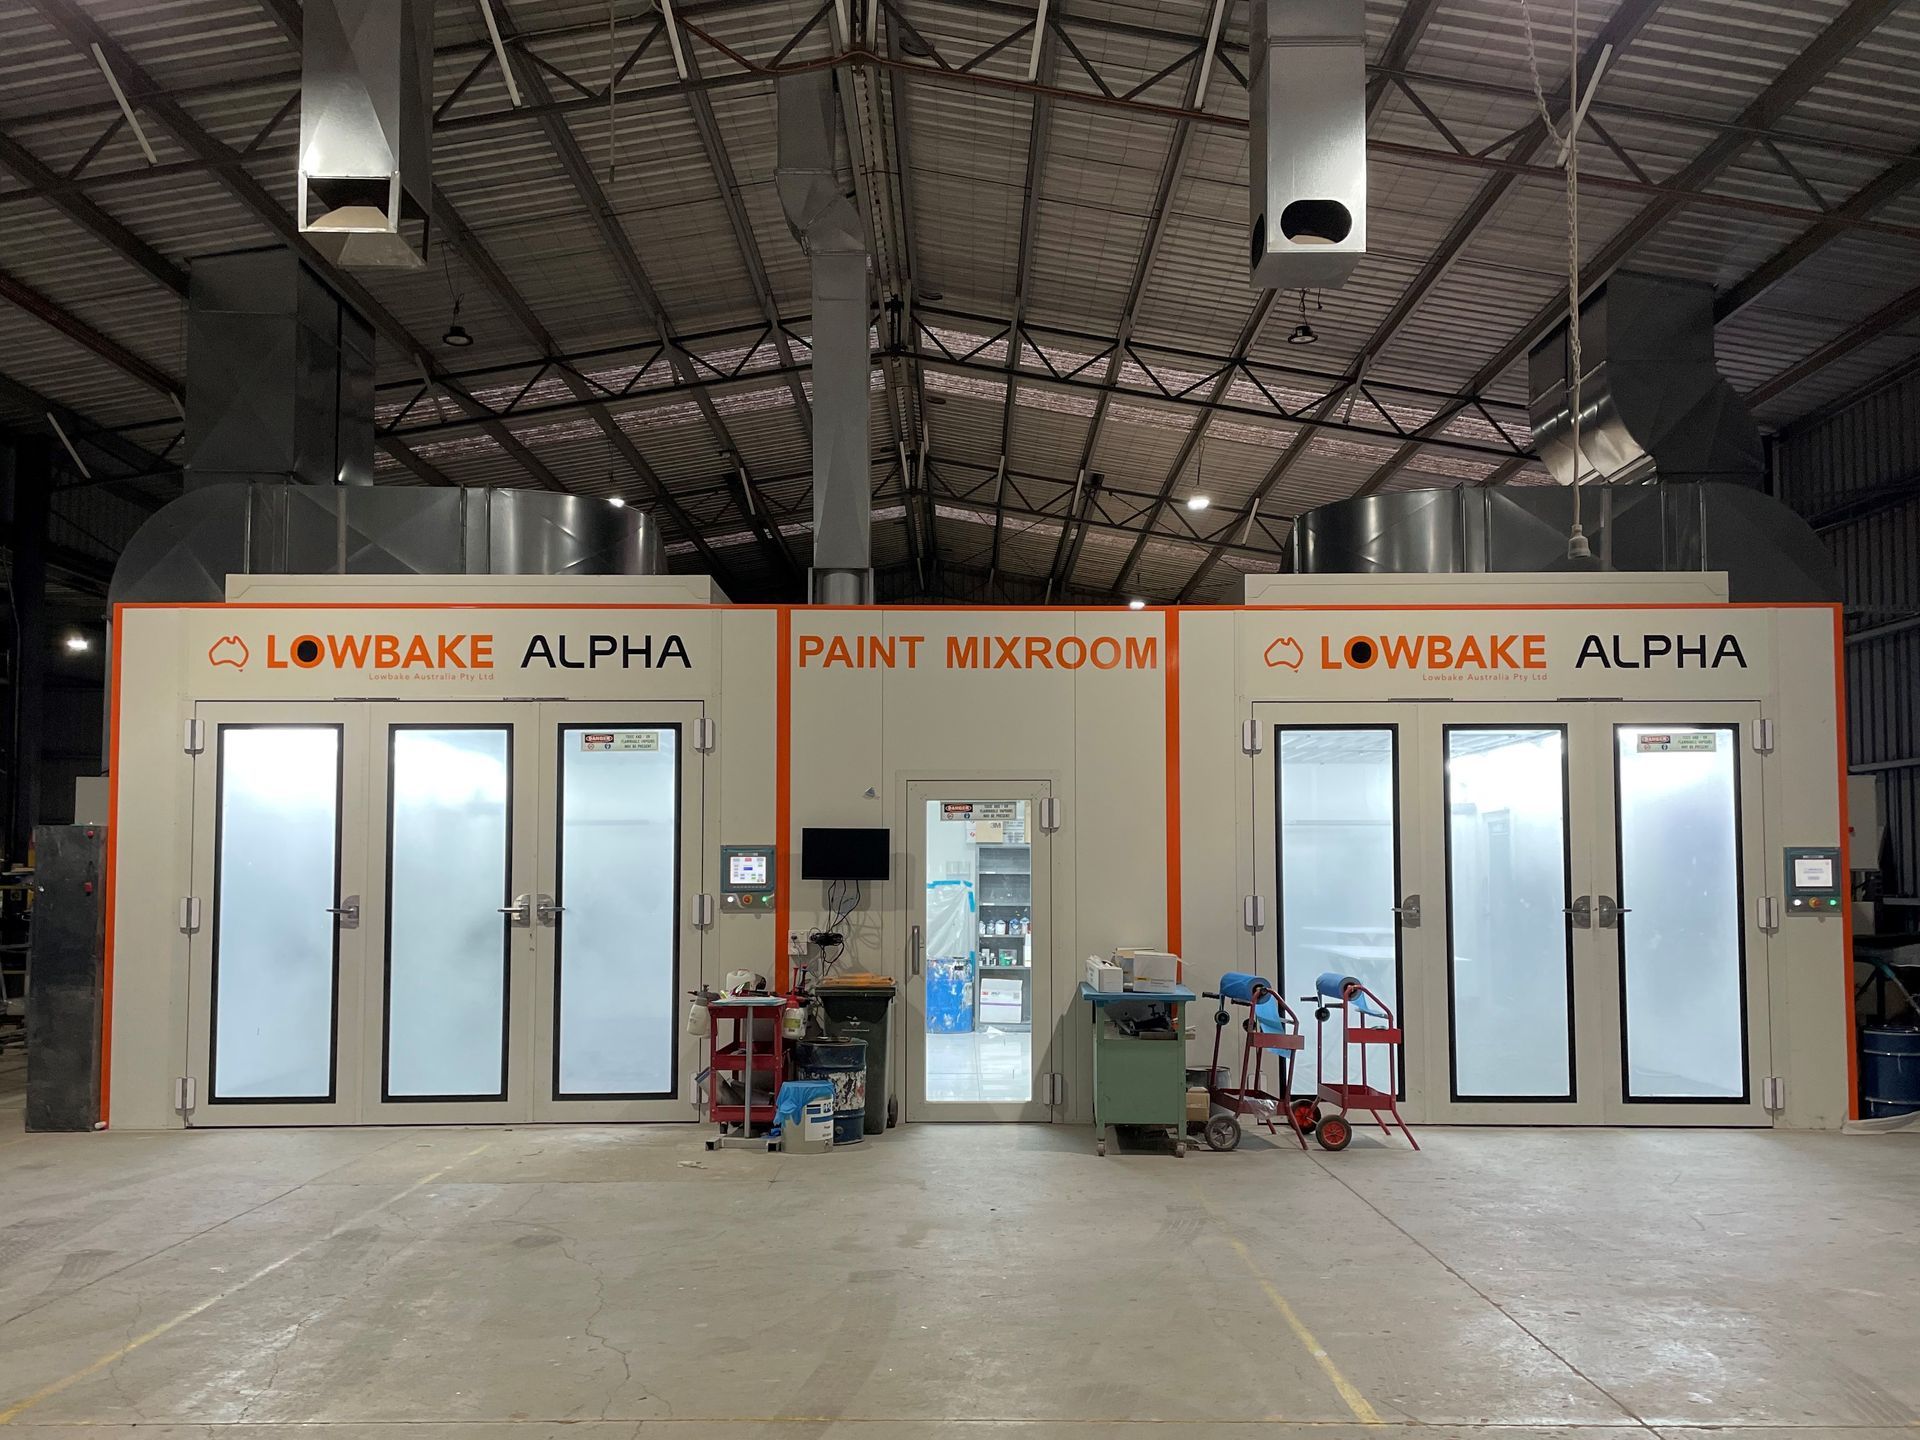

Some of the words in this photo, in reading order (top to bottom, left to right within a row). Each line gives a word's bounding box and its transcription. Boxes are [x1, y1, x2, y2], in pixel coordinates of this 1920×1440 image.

[267, 634, 494, 669] LOWBAKE
[521, 634, 692, 669] ALPHA
[799, 636, 924, 668] PAINT
[946, 636, 1157, 669] MIXROOM
[1321, 634, 1547, 669] LOWBAKE
[1575, 634, 1748, 669] ALPHA
[369, 672, 410, 681] Lowbake
[414, 672, 456, 681] Australia
[460, 672, 474, 682] Pty
[478, 672, 494, 681] Ltd
[1422, 673, 1464, 681] Lowbake
[1467, 673, 1509, 681] Australia
[1513, 673, 1528, 682] Pty
[1532, 673, 1548, 681] Ltd
